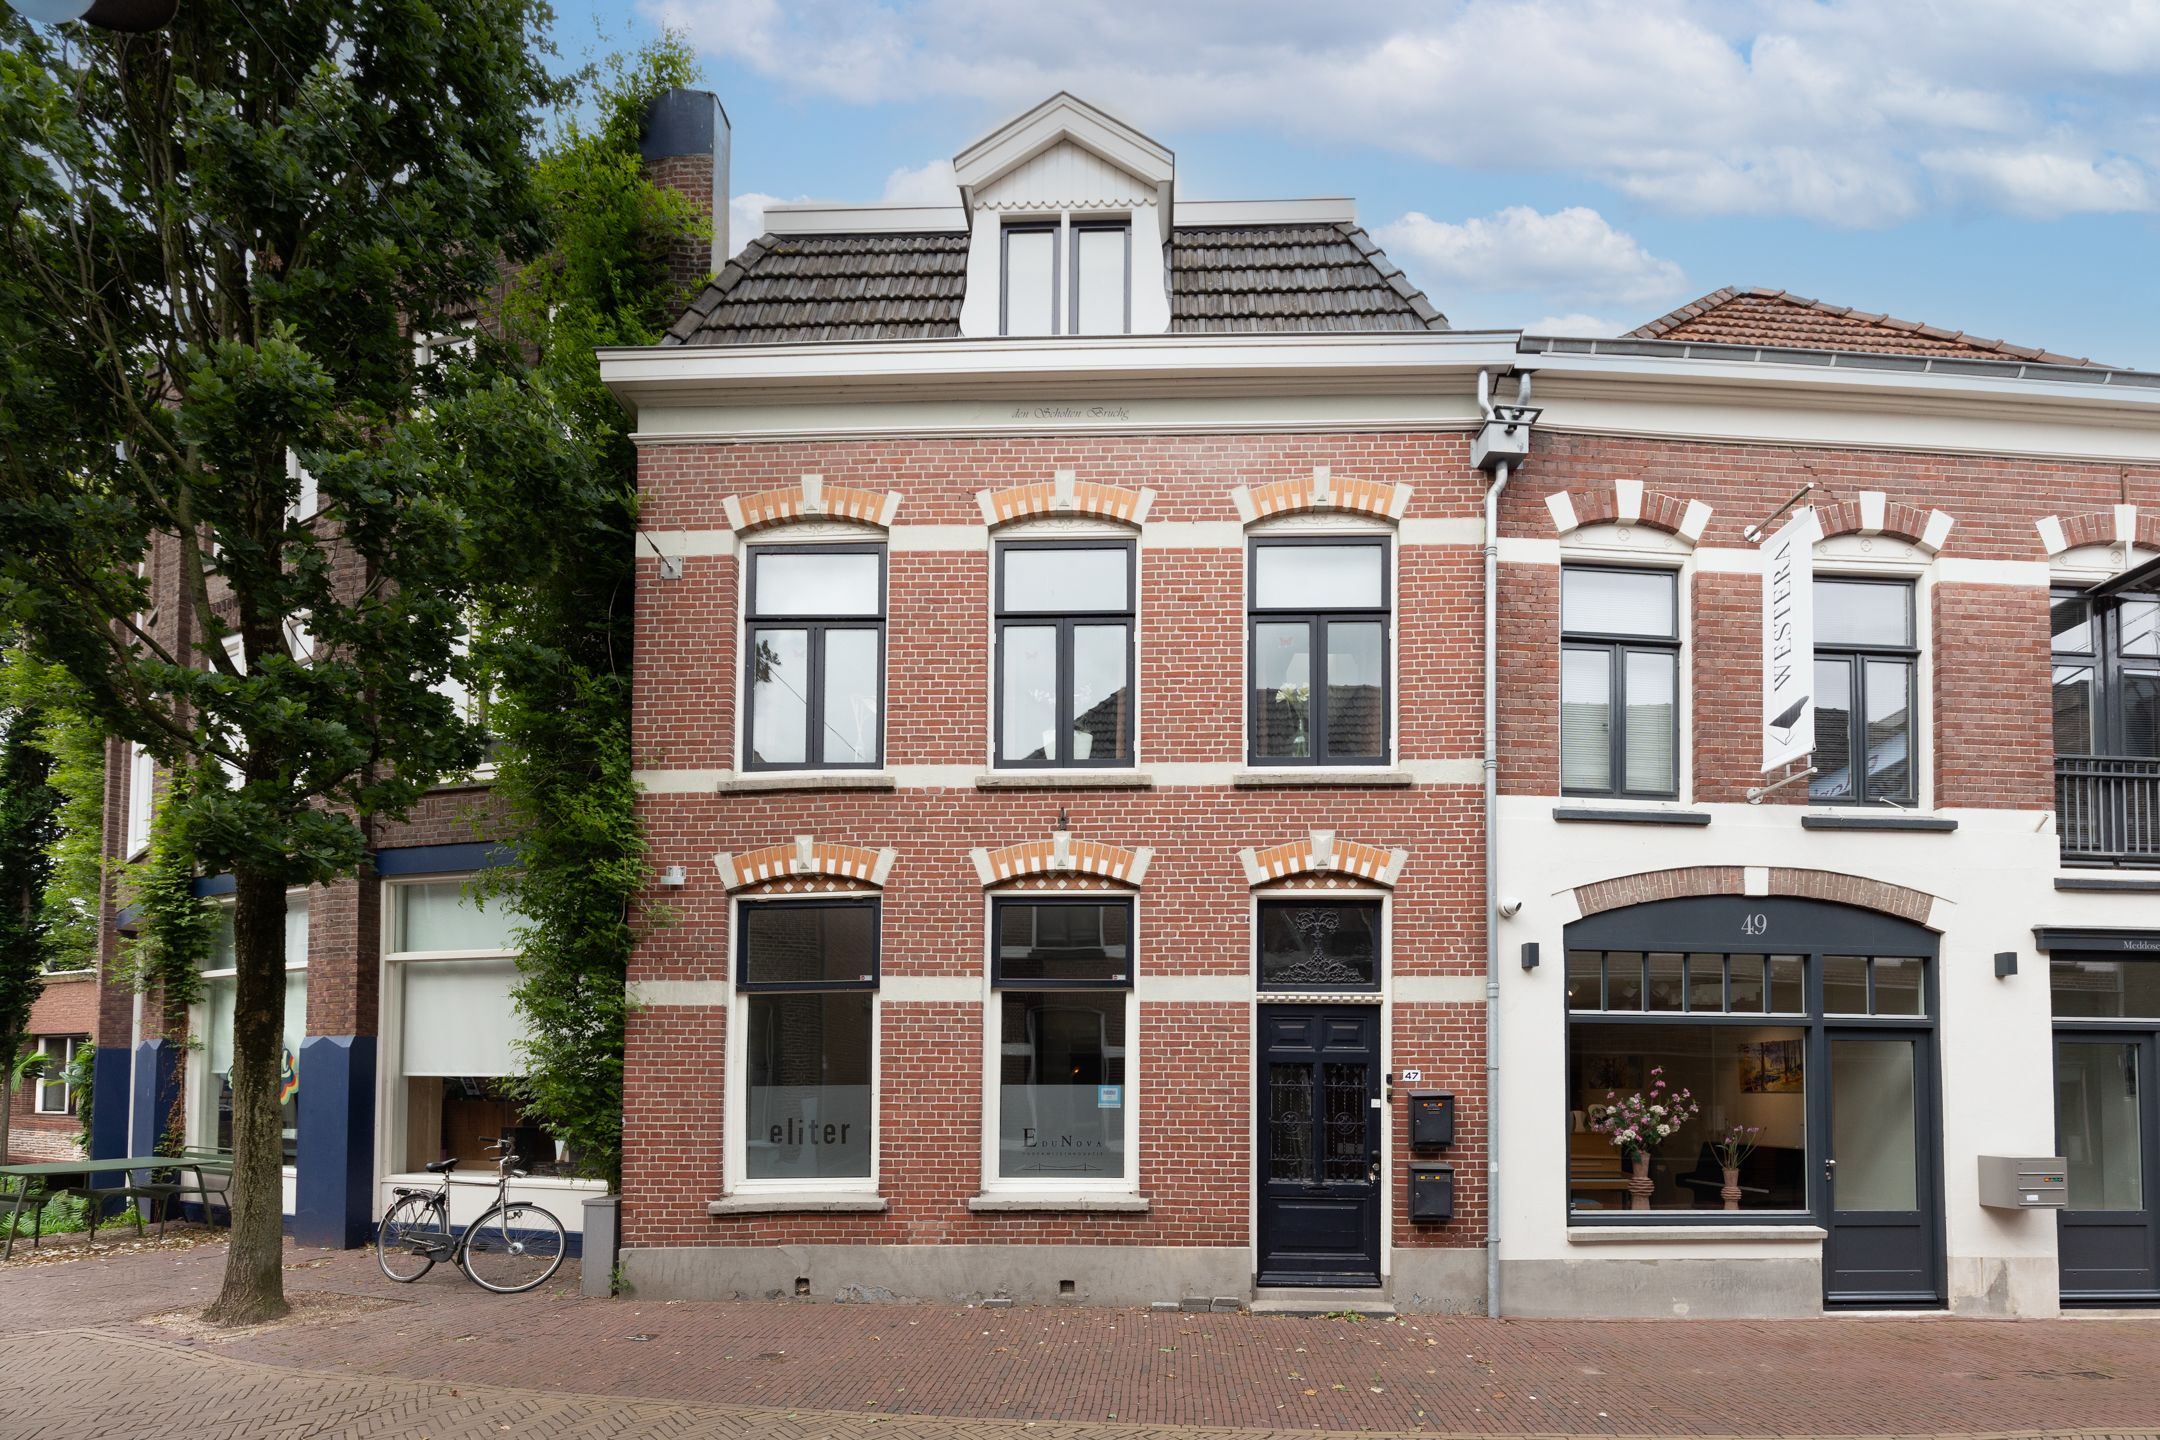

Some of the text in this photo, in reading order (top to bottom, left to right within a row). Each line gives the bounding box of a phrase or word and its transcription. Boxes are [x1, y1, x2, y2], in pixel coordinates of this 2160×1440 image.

[1773, 540, 1792, 693] WESTERA
[1740, 913, 1768, 936] 49
[1404, 1071, 1419, 1080] 47
[769, 1117, 851, 1145] eliter
